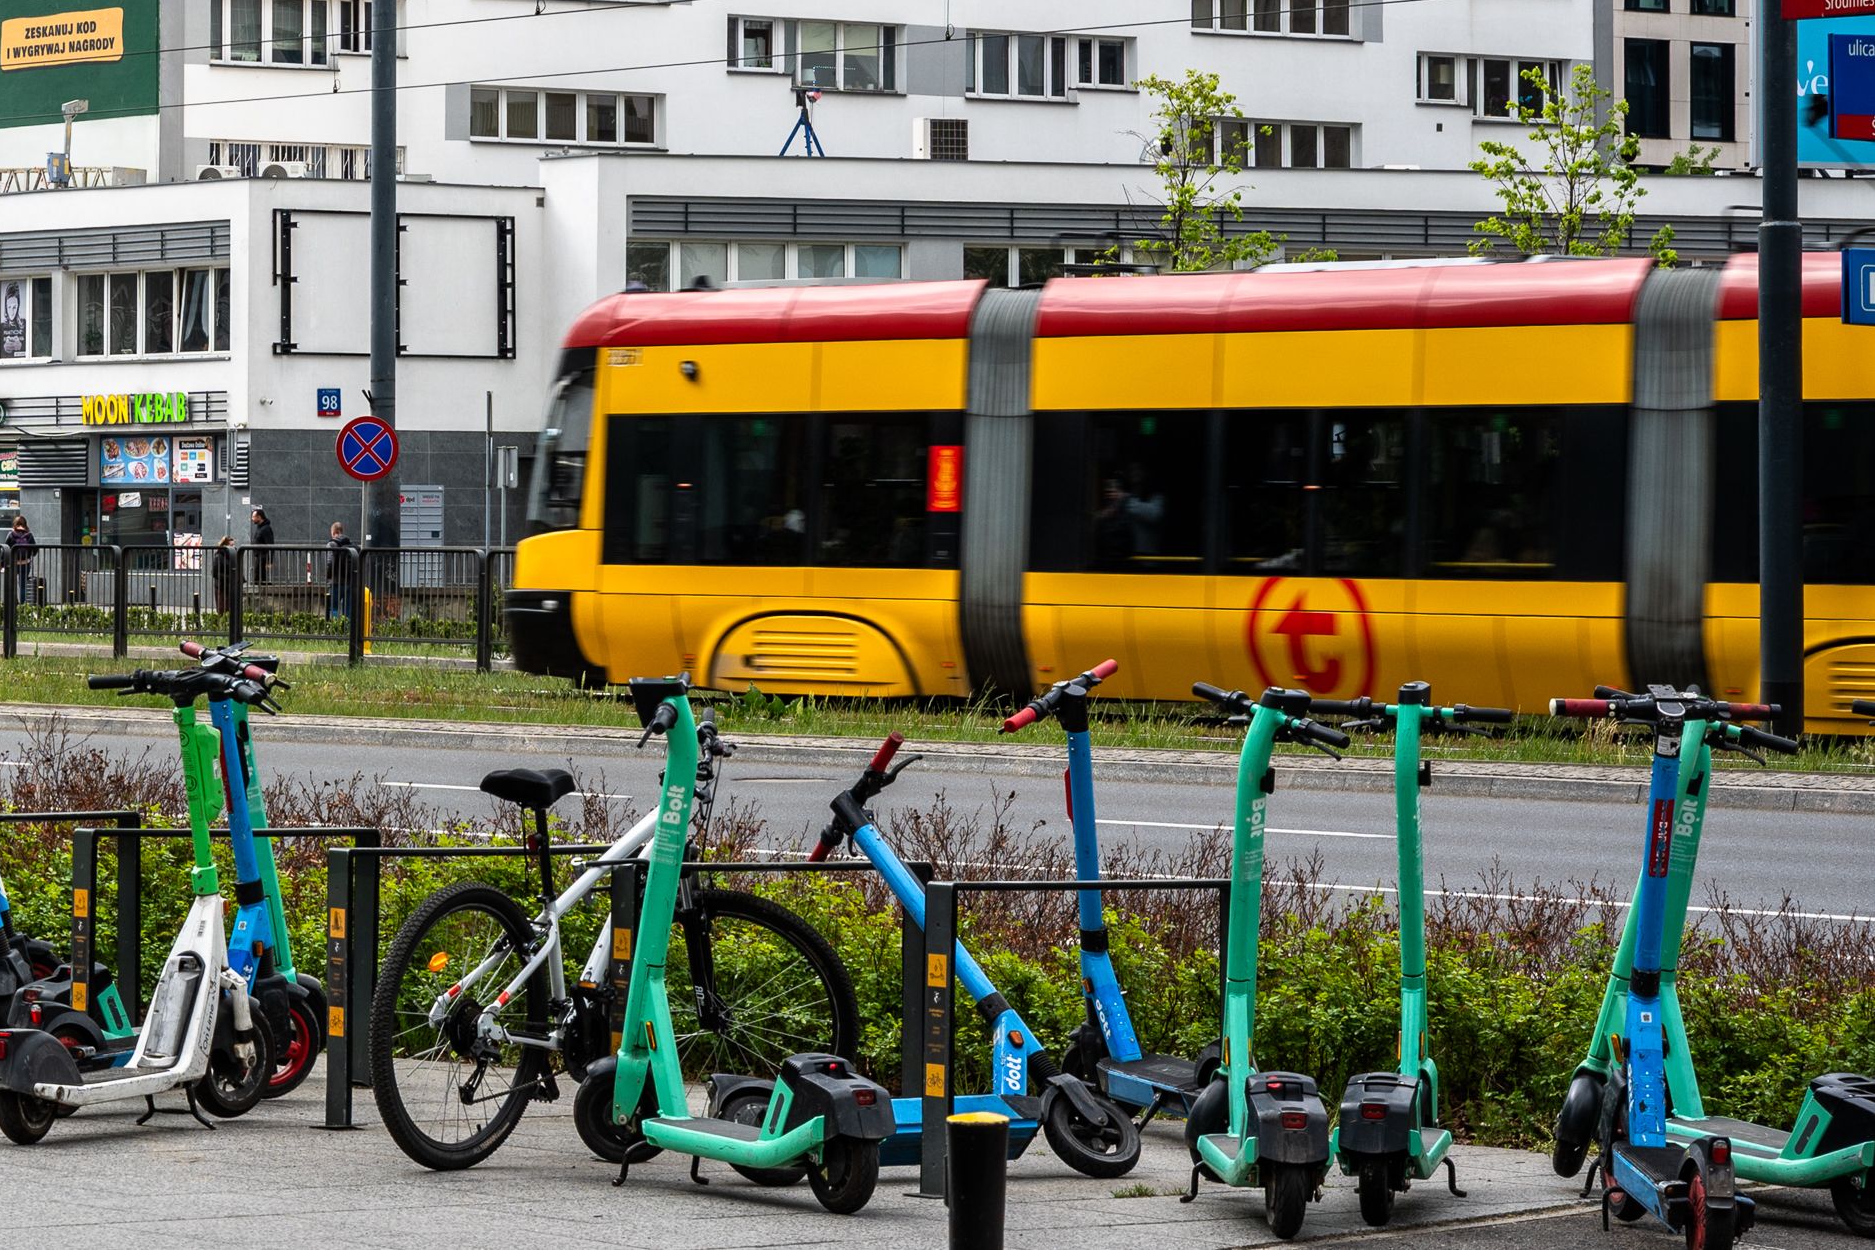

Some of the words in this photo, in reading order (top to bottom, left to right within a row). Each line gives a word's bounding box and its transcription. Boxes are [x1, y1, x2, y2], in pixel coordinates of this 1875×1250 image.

[6, 47, 11, 59] I
[12, 41, 65, 59] WYGRYWAJ
[68, 36, 115, 54] NAGRODY
[24, 23, 73, 40] ZESKANUJ
[76, 20, 97, 35] KOD
[81, 394, 129, 425] MOON
[134, 392, 187, 423] KEBAB
[321, 395, 338, 410] 98
[662, 784, 686, 825] Bolt
[1247, 797, 1266, 838] Bolt
[1676, 799, 1699, 837] Bolt
[1095, 998, 1111, 1040] dott
[1004, 1054, 1022, 1091] dott
